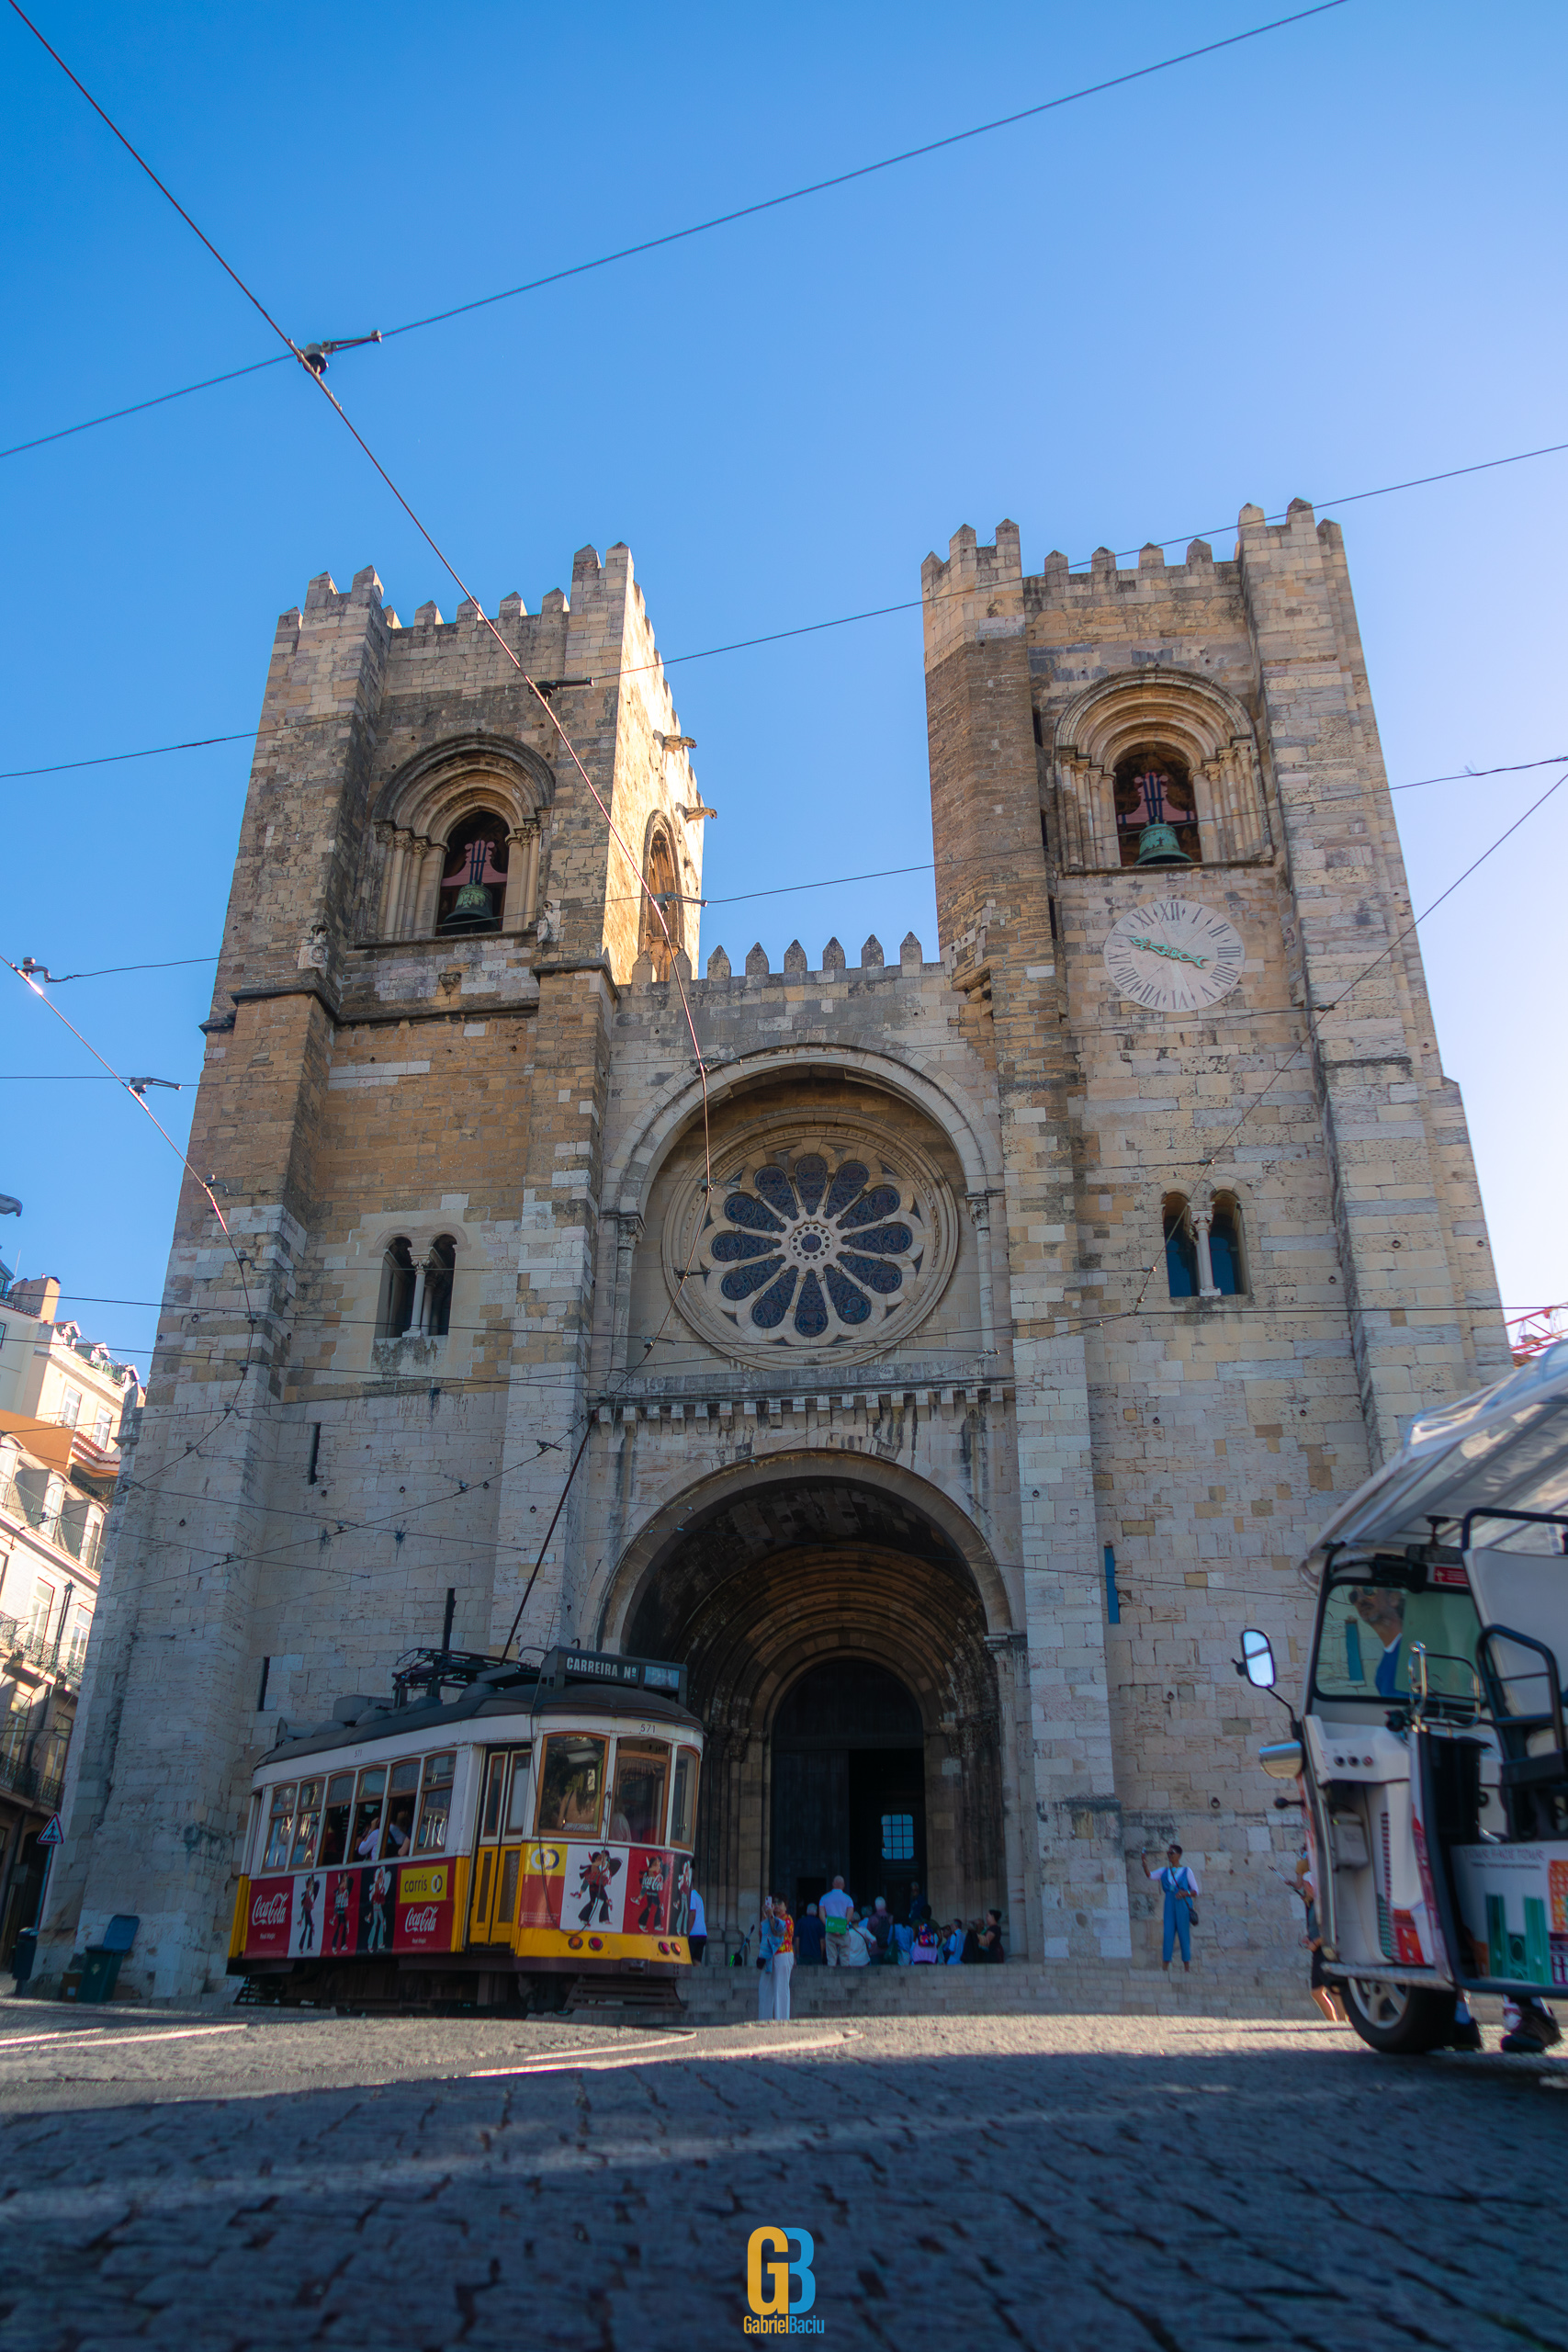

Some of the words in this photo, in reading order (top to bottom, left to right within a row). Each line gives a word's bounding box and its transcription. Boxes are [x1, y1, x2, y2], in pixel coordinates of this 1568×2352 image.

[1132, 908, 1156, 930] XI
[1159, 902, 1180, 922] XII
[1208, 922, 1230, 938] II
[1108, 952, 1131, 965] IX
[1217, 946, 1241, 958] III
[1113, 967, 1143, 994] VIII
[1209, 964, 1239, 986] IIII
[1138, 983, 1161, 1007] VII
[1171, 989, 1190, 1010] VI
[1200, 985, 1217, 1003] V
[566, 1657, 618, 1677] CARREIRA
[624, 1666, 637, 1679] Nº
[640, 1724, 656, 1734] 571
[404, 1874, 428, 1894] carris
